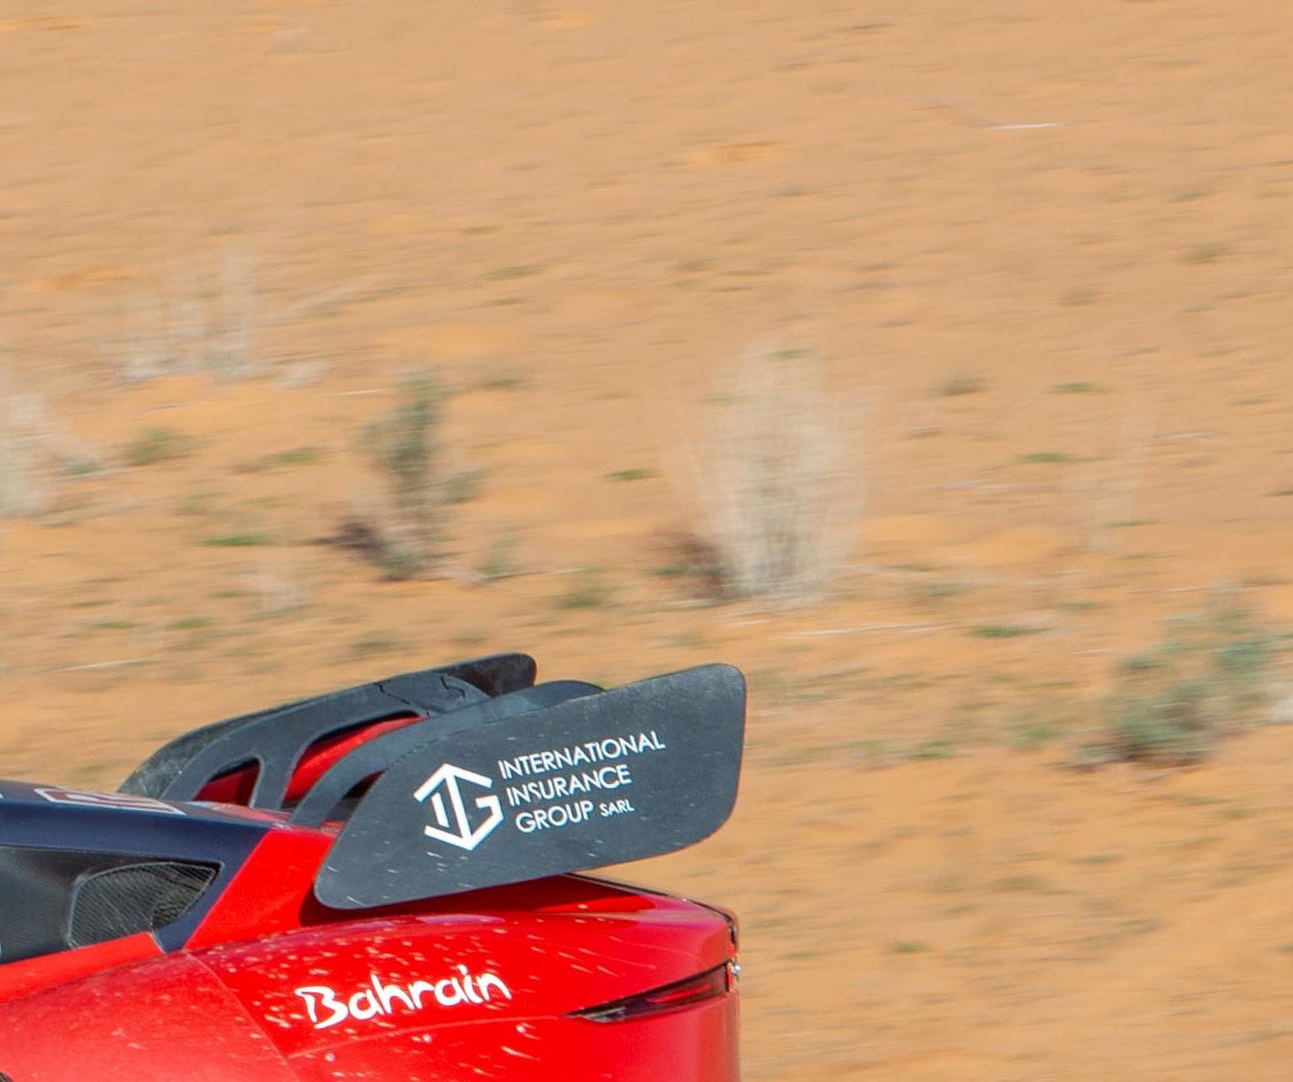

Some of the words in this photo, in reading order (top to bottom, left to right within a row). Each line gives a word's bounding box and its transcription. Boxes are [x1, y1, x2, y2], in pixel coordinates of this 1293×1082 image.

[498, 730, 666, 780] INTERNATIONAL
[506, 764, 633, 806] INSURANCE
[516, 800, 594, 833] GROUP
[600, 799, 635, 817] SARL
[294, 964, 512, 1029] Bahrain
